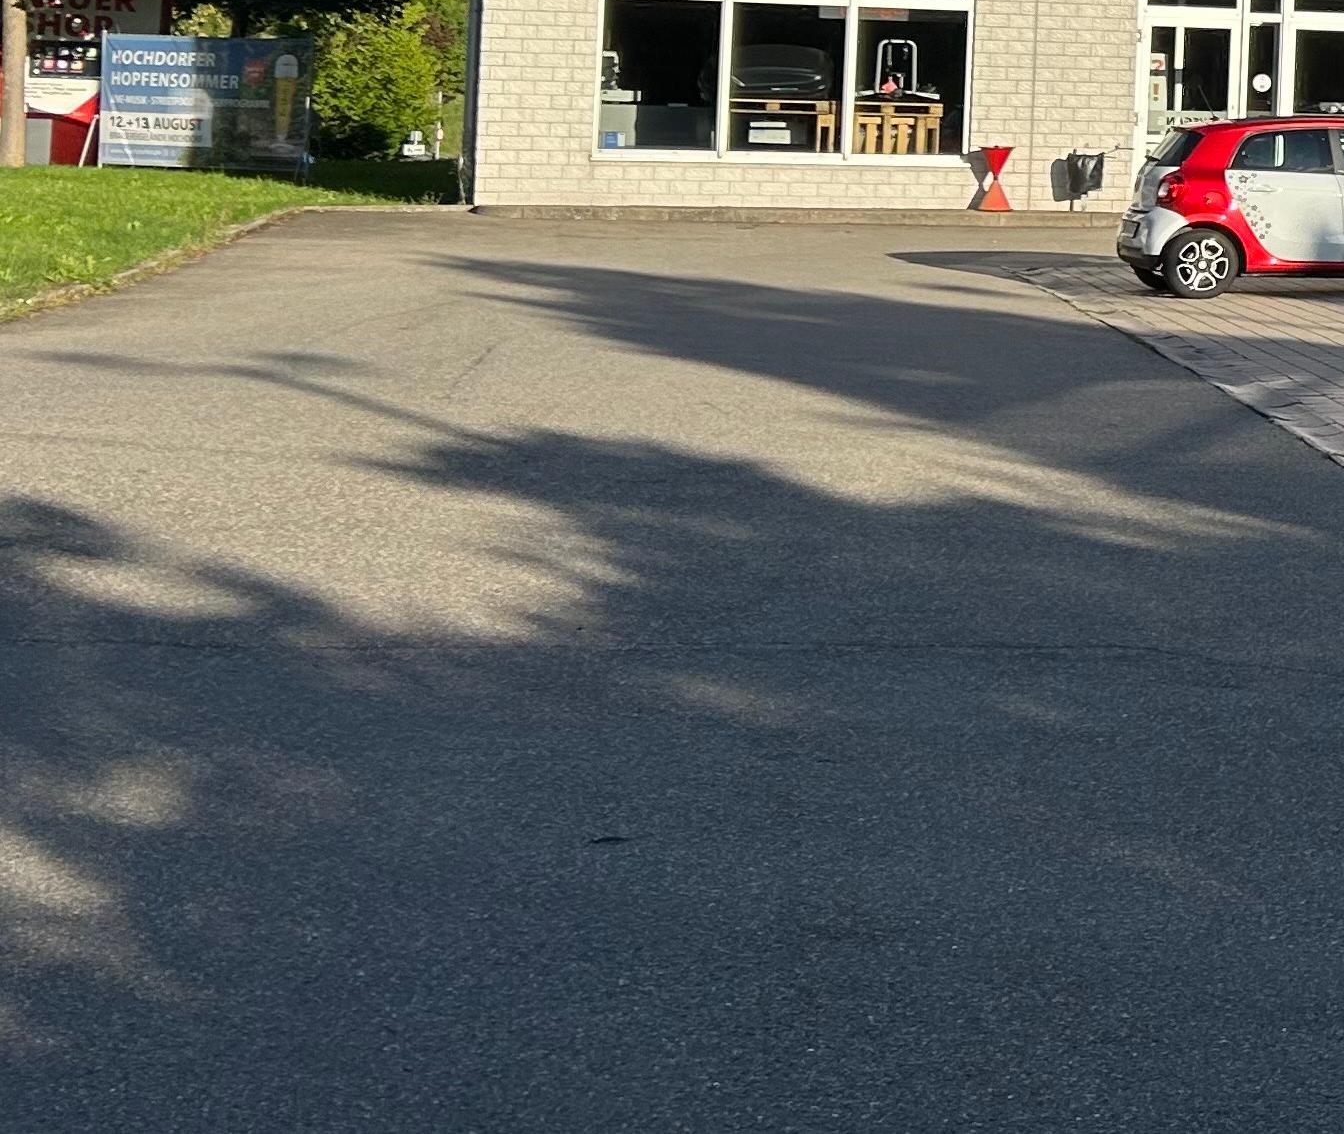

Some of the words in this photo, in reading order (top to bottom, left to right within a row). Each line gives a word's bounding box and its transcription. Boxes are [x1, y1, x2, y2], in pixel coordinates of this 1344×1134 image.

[27, 12, 113, 38] HOP
[112, 50, 215, 67] HOCHDORFER
[112, 71, 240, 89] HOPFENSOMMER
[153, 117, 204, 131] AUGUST
